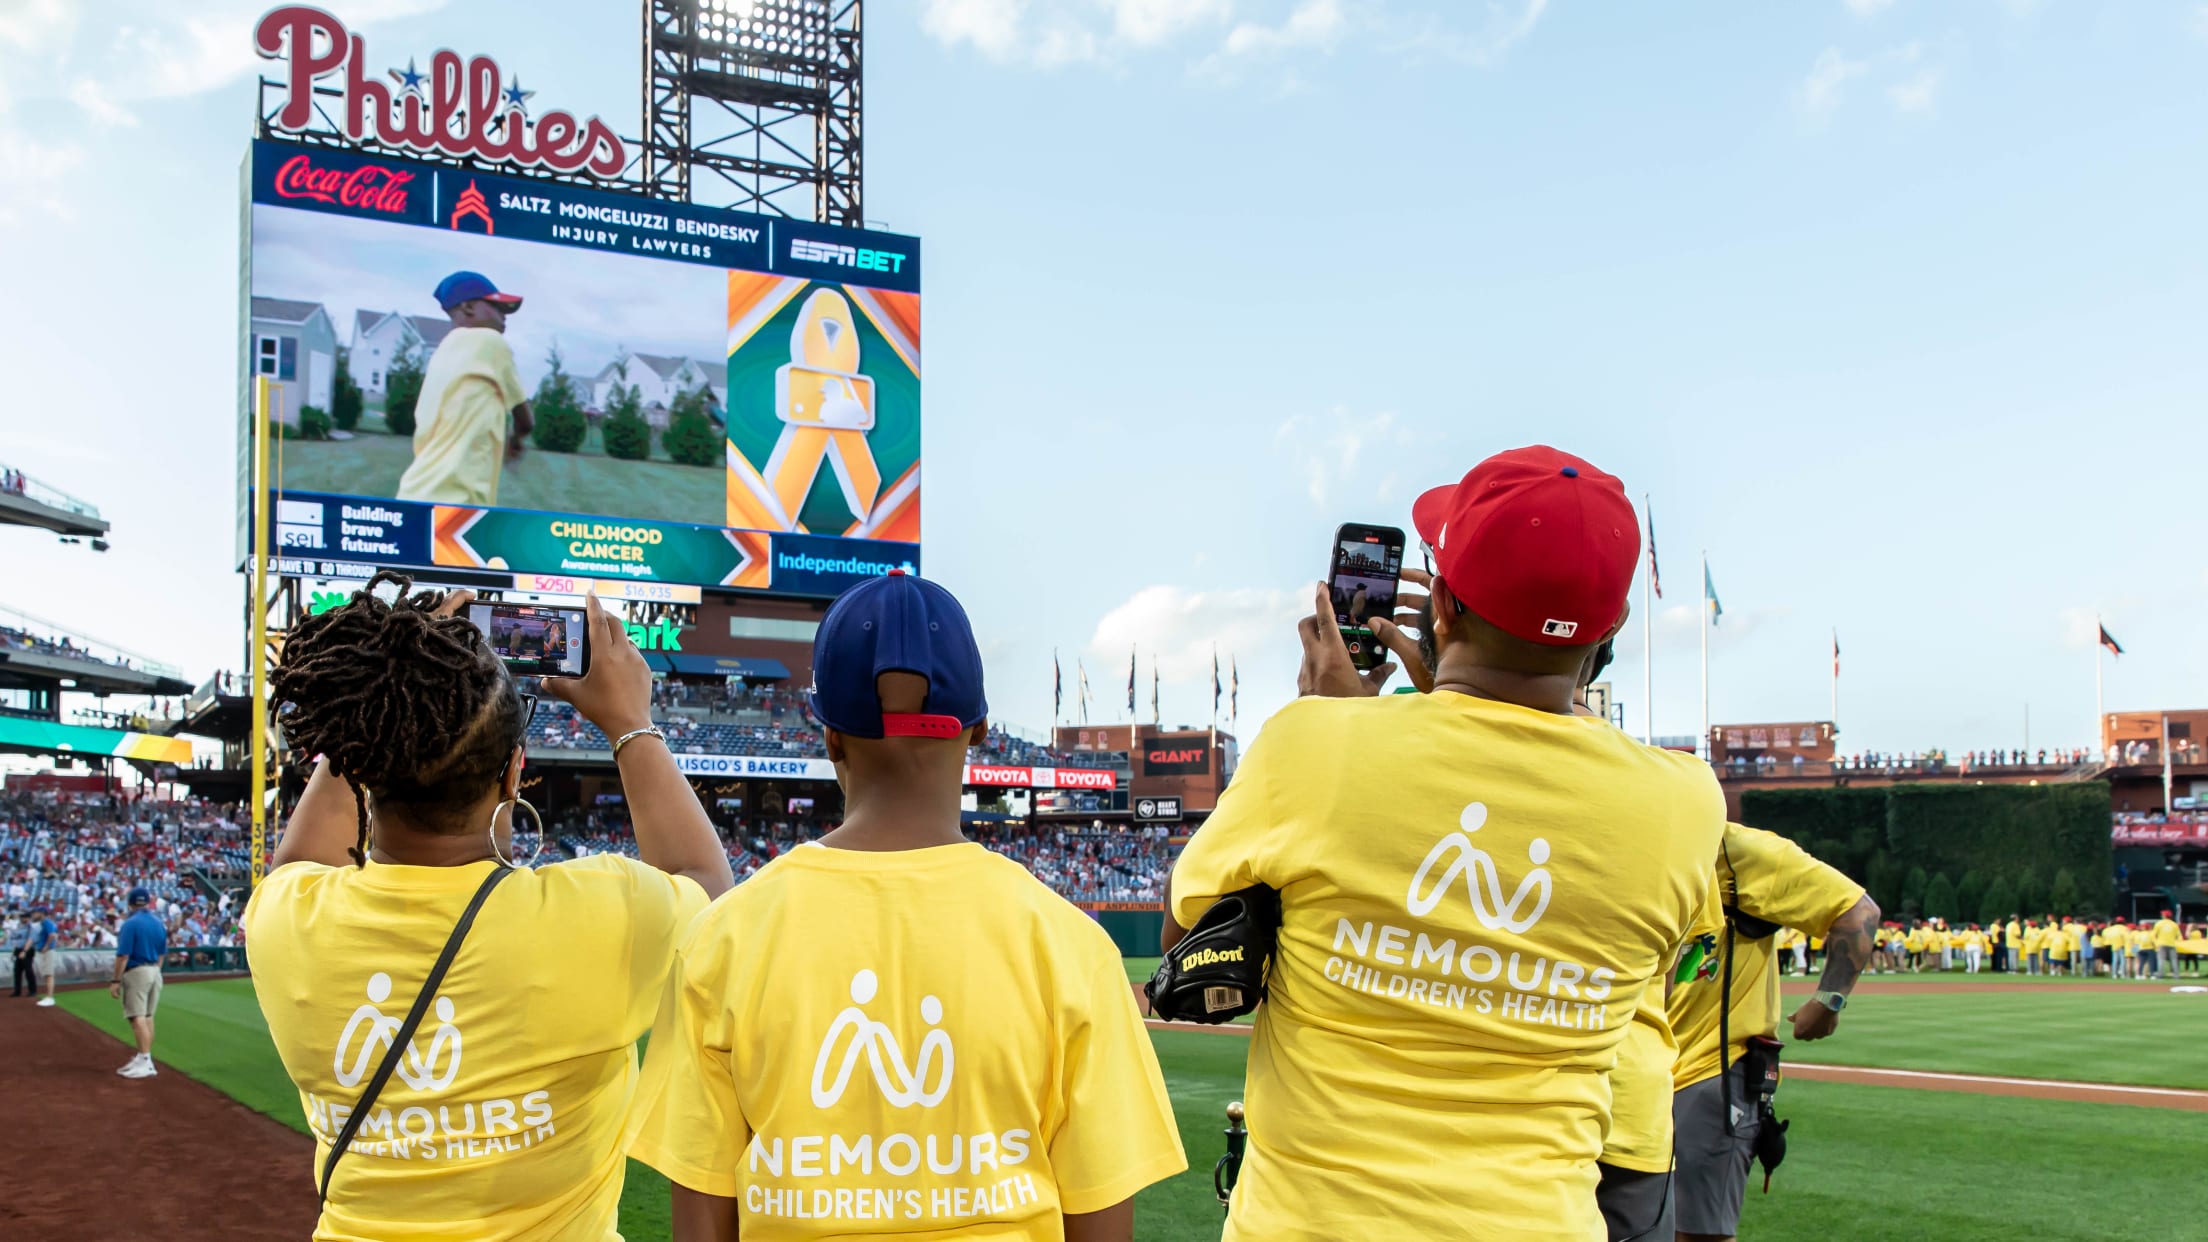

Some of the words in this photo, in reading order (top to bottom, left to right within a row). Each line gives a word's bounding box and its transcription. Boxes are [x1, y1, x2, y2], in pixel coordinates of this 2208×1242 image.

[255, 5, 626, 178] Phillies
[275, 155, 415, 212] Coca-Cola
[500, 193, 551, 214] SALTZ
[560, 202, 668, 230] MONGELUZZI
[676, 219, 759, 243] BENDESKY
[552, 225, 618, 245] INJURY
[632, 236, 711, 258] LAWYERS
[790, 239, 856, 267] ESPN
[857, 248, 906, 273] BET
[341, 505, 403, 526] Building
[341, 521, 383, 538] brave
[550, 521, 662, 544] CHILDHOOD
[341, 537, 400, 554] futures.
[569, 541, 644, 561] CANCER
[279, 559, 302, 574] HAVE
[303, 561, 315, 574] TO
[321, 562, 334, 575] GO
[561, 559, 620, 572] Awareness
[621, 563, 652, 576] Night
[779, 552, 894, 575] Independence
[625, 584, 671, 599] $16,935
[624, 618, 682, 651] ark
[677, 759, 742, 772] LISCIO'S
[748, 761, 808, 774] BAKERY
[1149, 749, 1203, 763] GIANT
[973, 768, 1030, 784] TOYOTA
[1058, 771, 1113, 786] TOYOTA
[253, 823, 262, 878] 329
[1182, 948, 1244, 972] Wilson
[1332, 918, 1616, 1001] NEMOURS
[1324, 956, 1494, 1015] CHILDREN'S
[1501, 993, 1607, 1031] HEALTH
[750, 1129, 1031, 1177] NEMOURS
[746, 1183, 923, 1219] CHILDREN'S
[932, 1173, 1039, 1218] HEALTH
